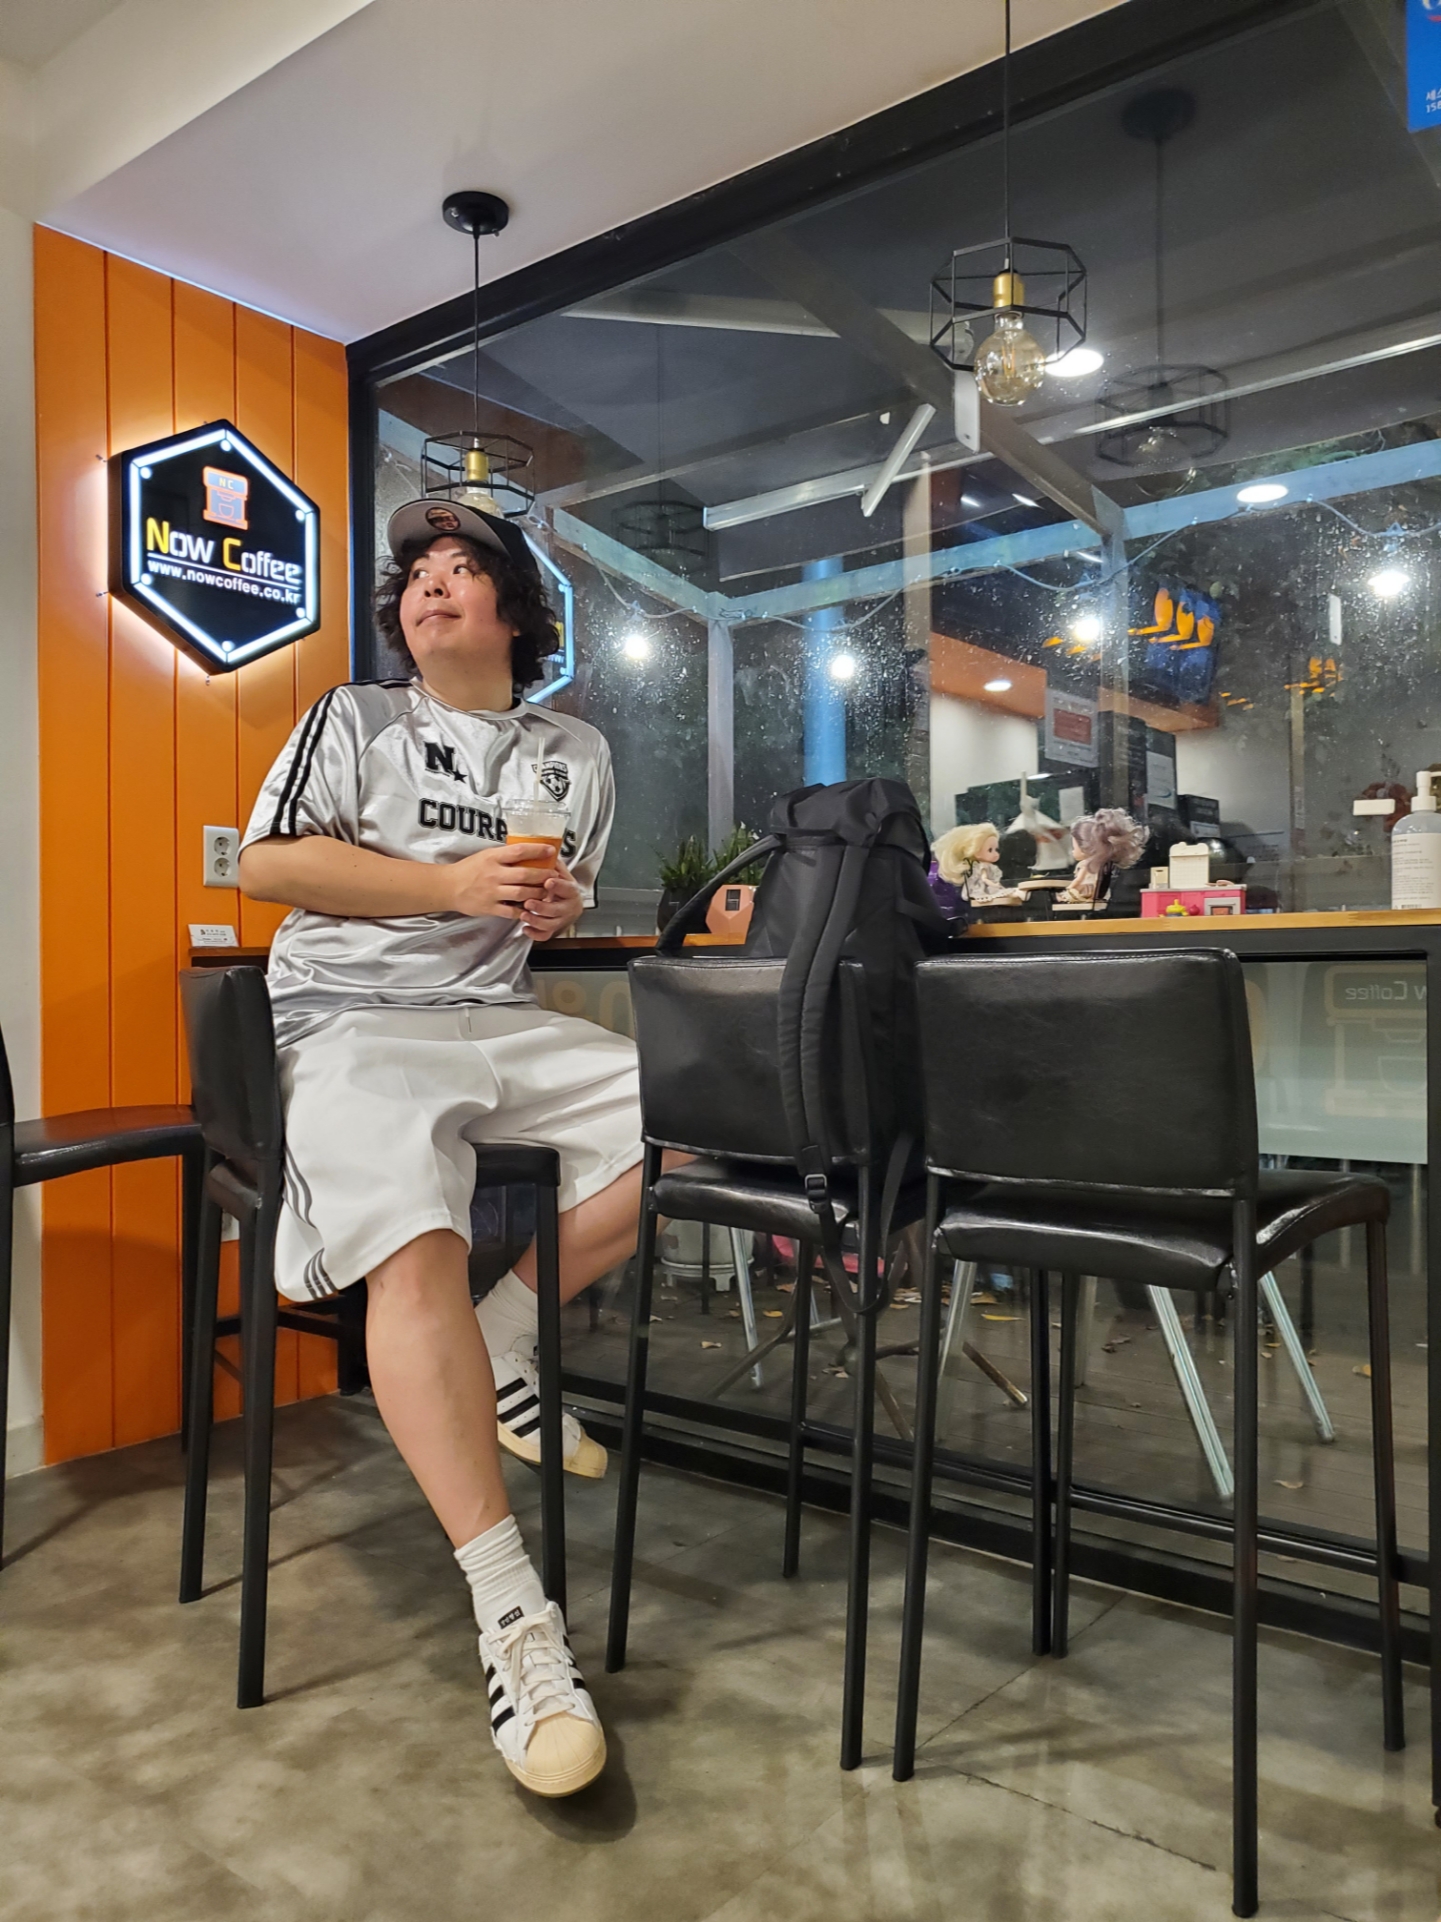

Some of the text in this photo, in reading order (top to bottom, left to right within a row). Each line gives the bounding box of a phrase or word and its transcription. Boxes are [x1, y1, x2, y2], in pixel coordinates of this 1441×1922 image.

[147, 559, 303, 604] www.nowcoffee.co.kr
[223, 537, 303, 584] Coffee
[423, 741, 455, 774] N
